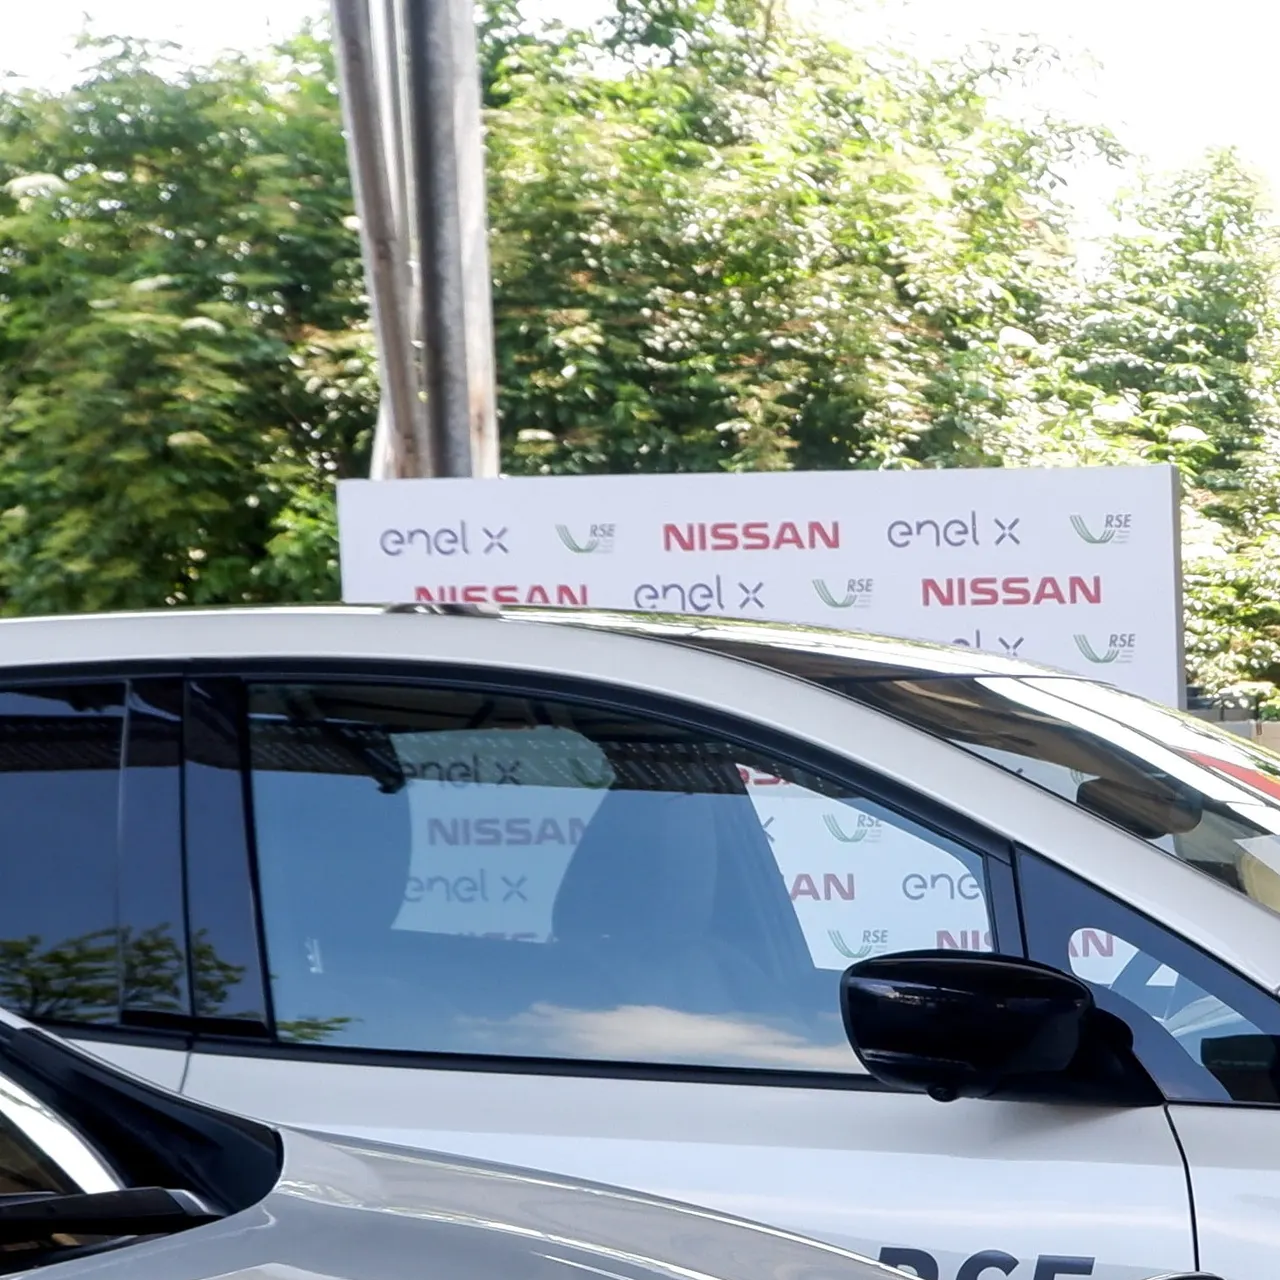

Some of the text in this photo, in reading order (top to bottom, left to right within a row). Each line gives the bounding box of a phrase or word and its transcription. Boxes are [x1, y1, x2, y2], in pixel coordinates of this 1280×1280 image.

[590, 523, 616, 538] RSE
[887, 510, 1021, 548] enel x
[1105, 514, 1131, 528] RSE
[380, 520, 509, 556] enel x
[663, 521, 840, 552] NISSAN
[634, 575, 765, 612] enel x
[847, 579, 874, 593] RSE
[921, 576, 1102, 606] NISSAN
[1109, 633, 1136, 648] RSE
[404, 868, 489, 903] enel
[902, 873, 980, 900] ene
[862, 930, 888, 944] RSE
